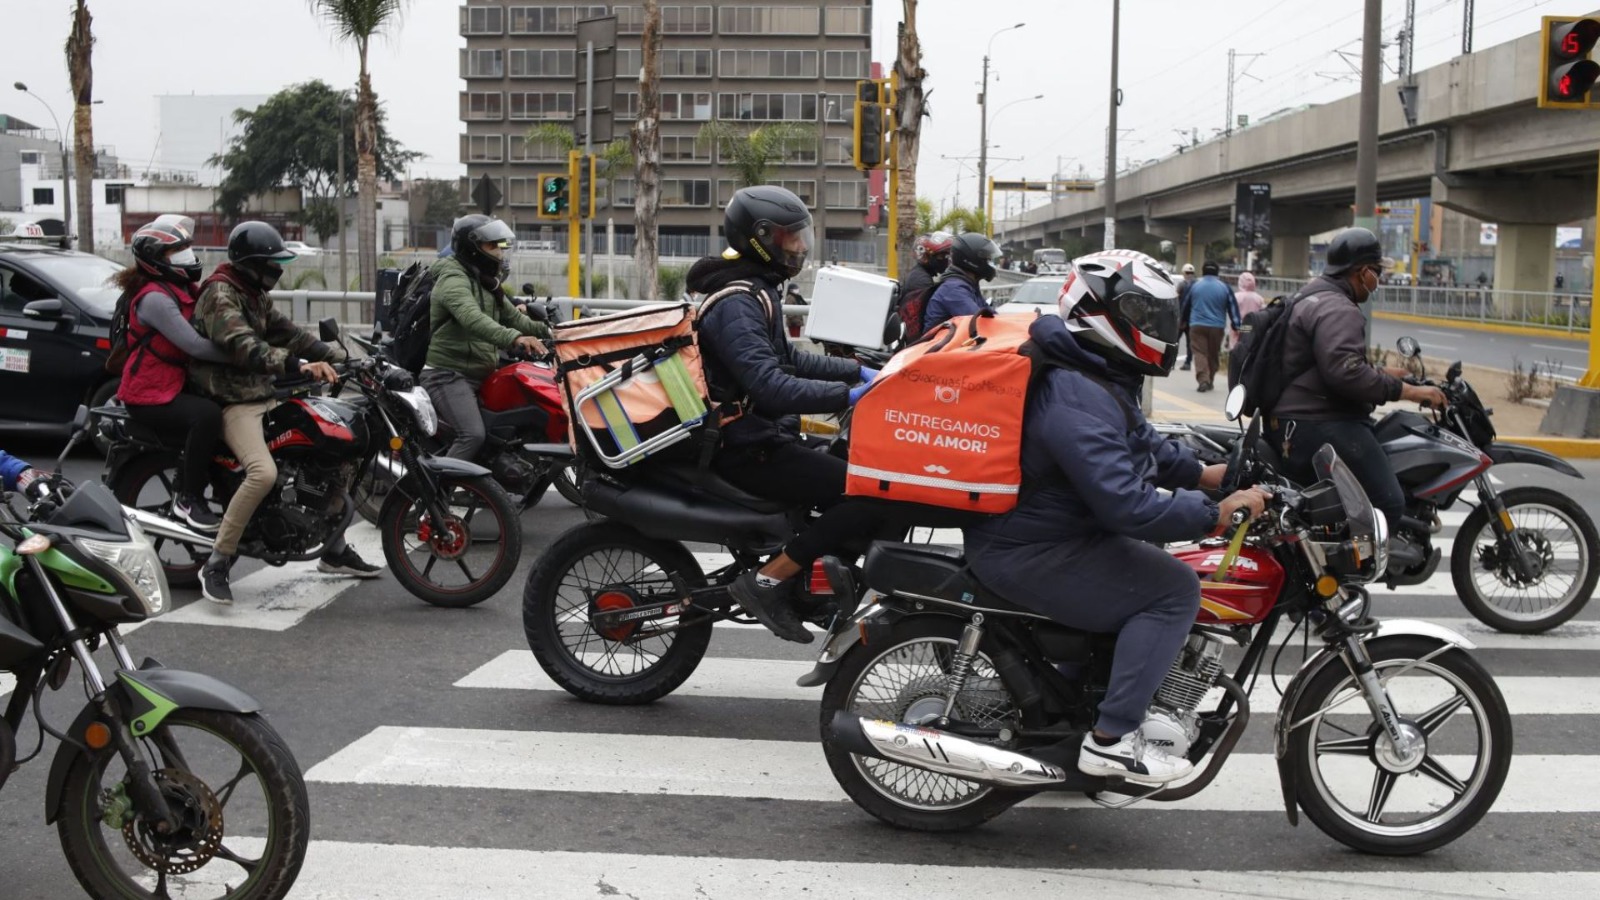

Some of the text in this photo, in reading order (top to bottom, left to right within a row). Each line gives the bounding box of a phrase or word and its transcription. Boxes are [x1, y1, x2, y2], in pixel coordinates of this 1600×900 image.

[1561, 32, 1579, 53] 15
[26, 226, 42, 236] TAXI
[884, 408, 1001, 439] ¡ENTREGAMOS
[276, 429, 293, 444] 150
[894, 428, 988, 454] CON AMOR!
